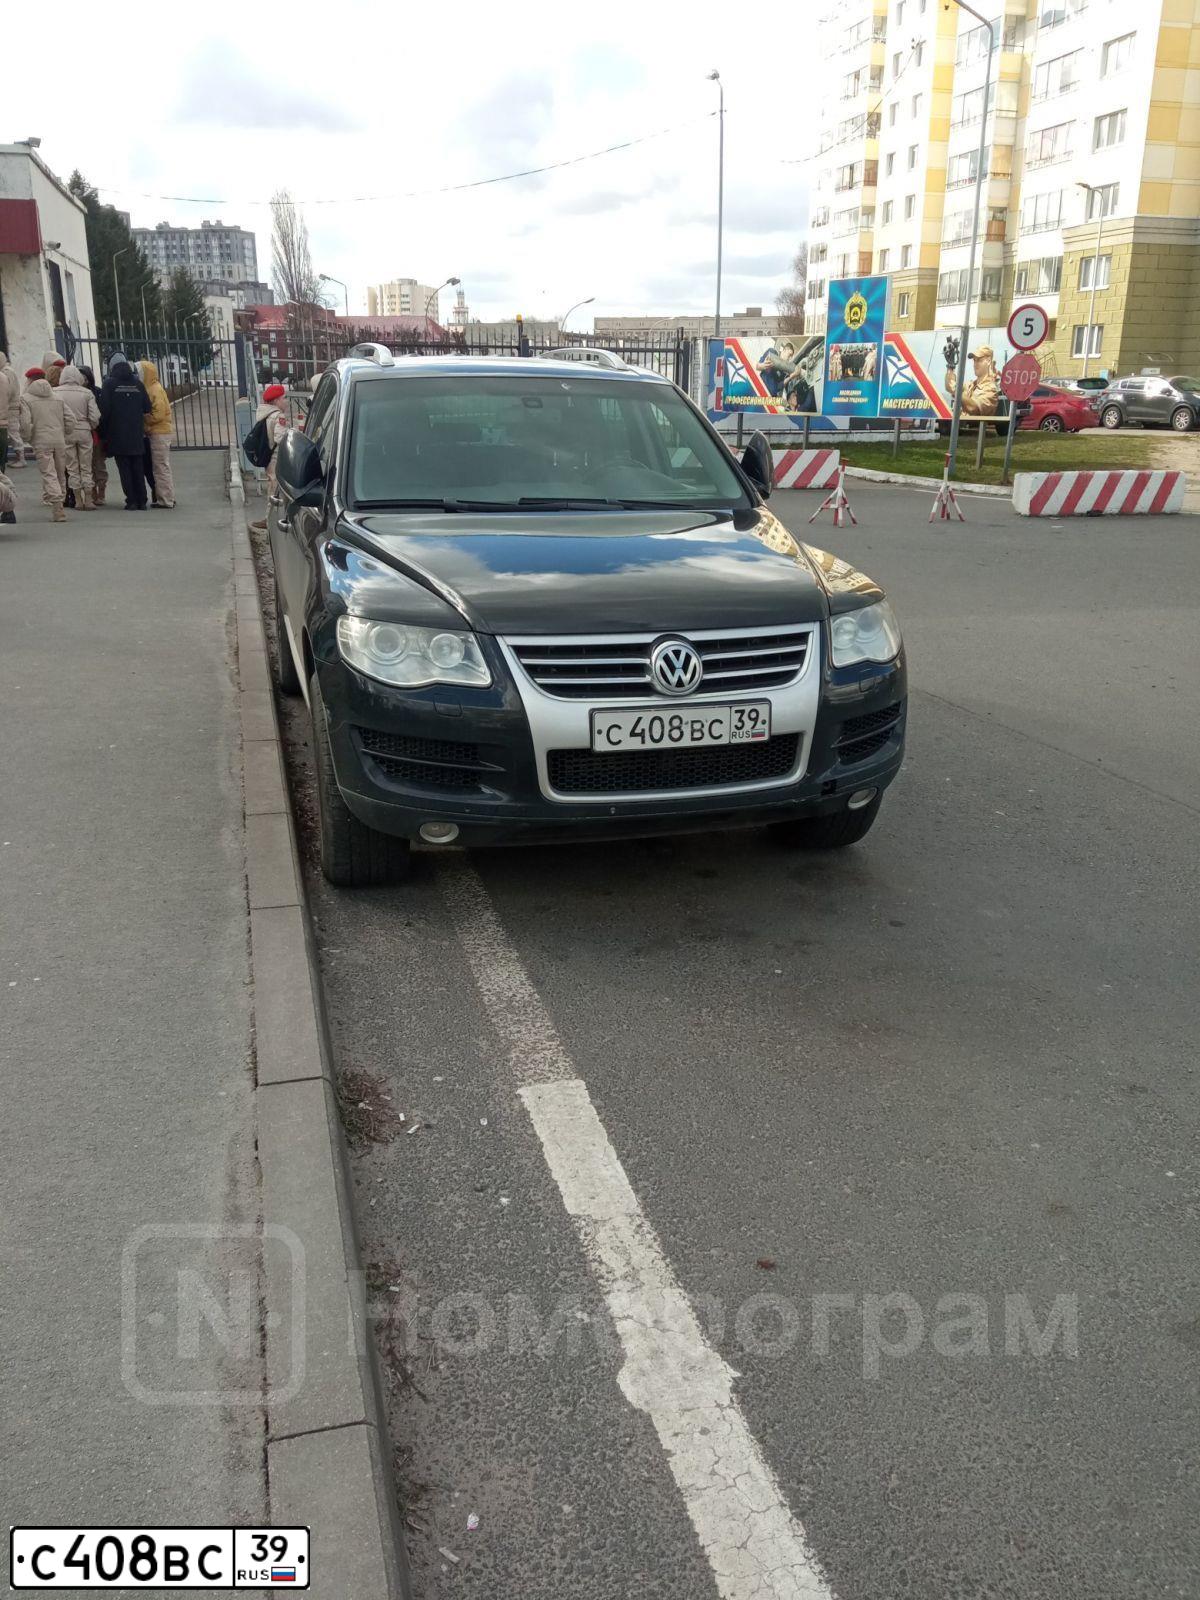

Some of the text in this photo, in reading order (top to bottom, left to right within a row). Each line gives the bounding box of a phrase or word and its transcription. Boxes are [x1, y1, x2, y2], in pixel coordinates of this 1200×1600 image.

[1023, 317, 1035, 336] 5
[1004, 369, 1038, 385] STOP
[882, 397, 932, 409] МАСТЕРСТВО!
[733, 707, 760, 731] 39
[731, 730, 750, 740] RUS
